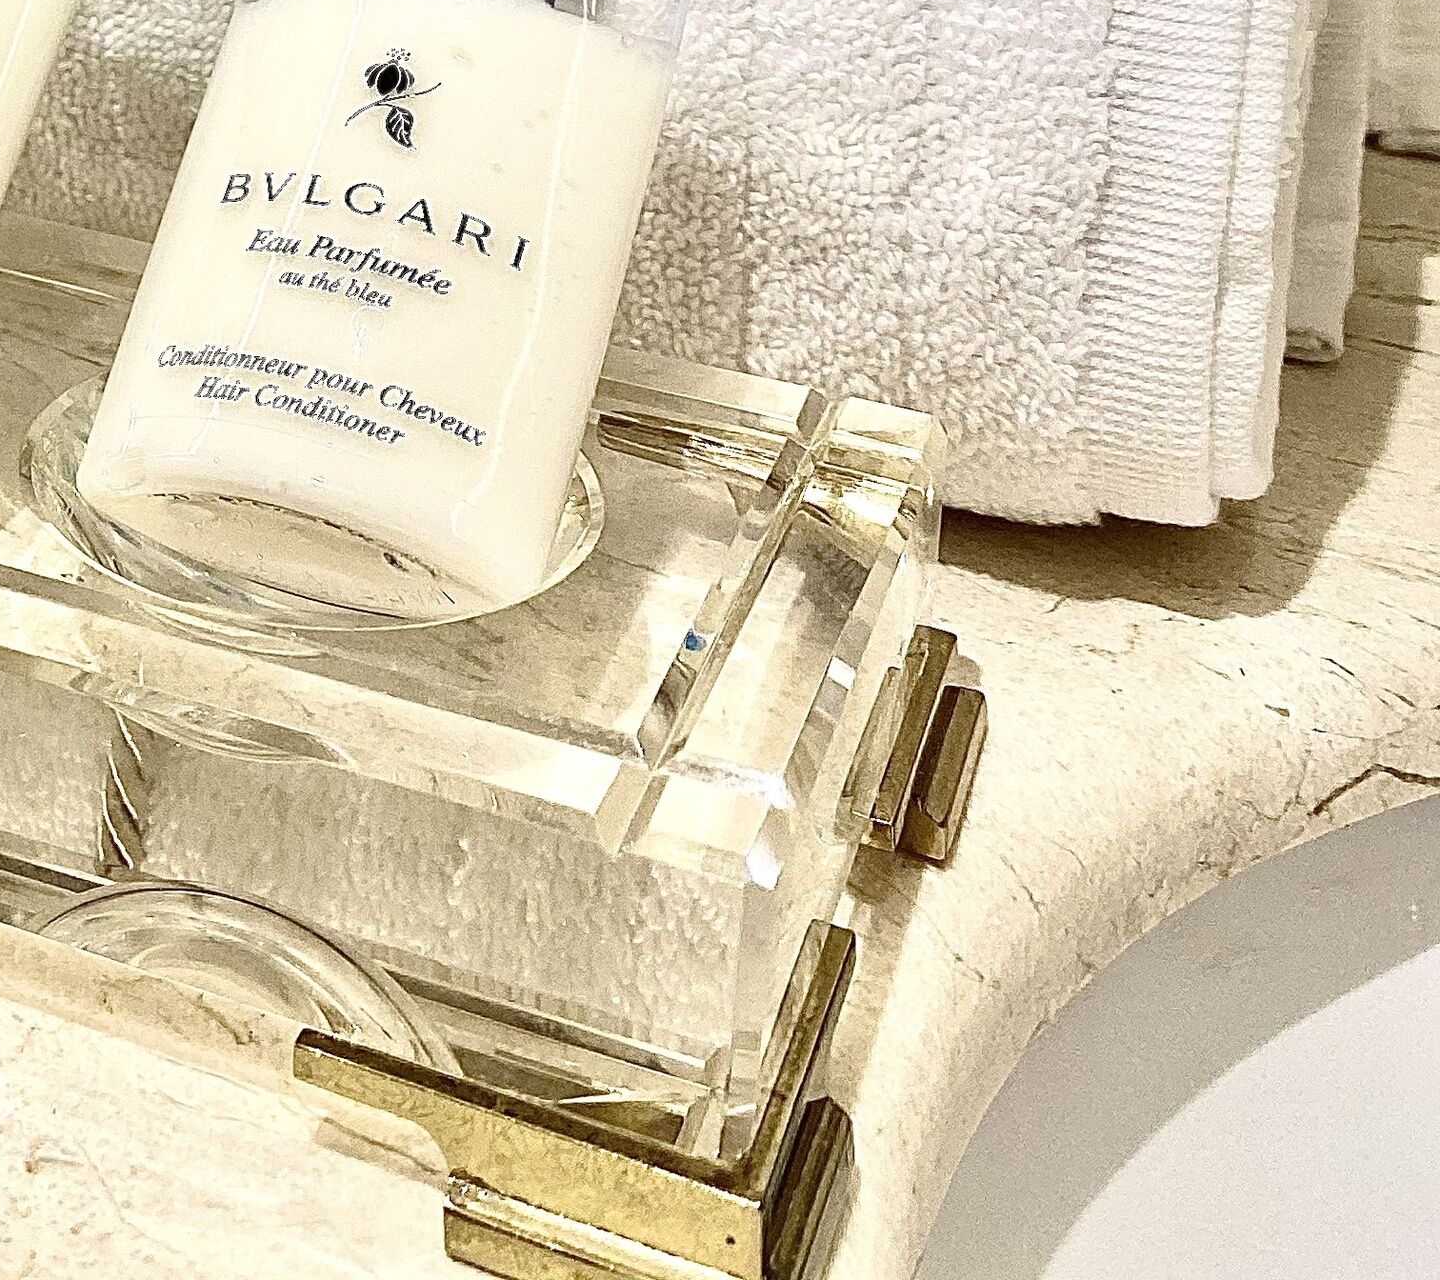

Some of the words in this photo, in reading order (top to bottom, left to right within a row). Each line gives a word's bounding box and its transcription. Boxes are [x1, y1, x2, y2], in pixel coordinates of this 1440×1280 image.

[220, 171, 531, 272] BVLGARI
[246, 229, 302, 255] Eau
[305, 235, 453, 296] Parfumée
[278, 270, 306, 287] au
[308, 270, 345, 294] thé
[345, 279, 394, 309] bleu
[157, 344, 308, 378] Conditionneur
[303, 366, 375, 397] pour
[378, 384, 487, 447] Cheveux
[193, 375, 251, 402] Hair
[254, 383, 406, 445] Conditioner
